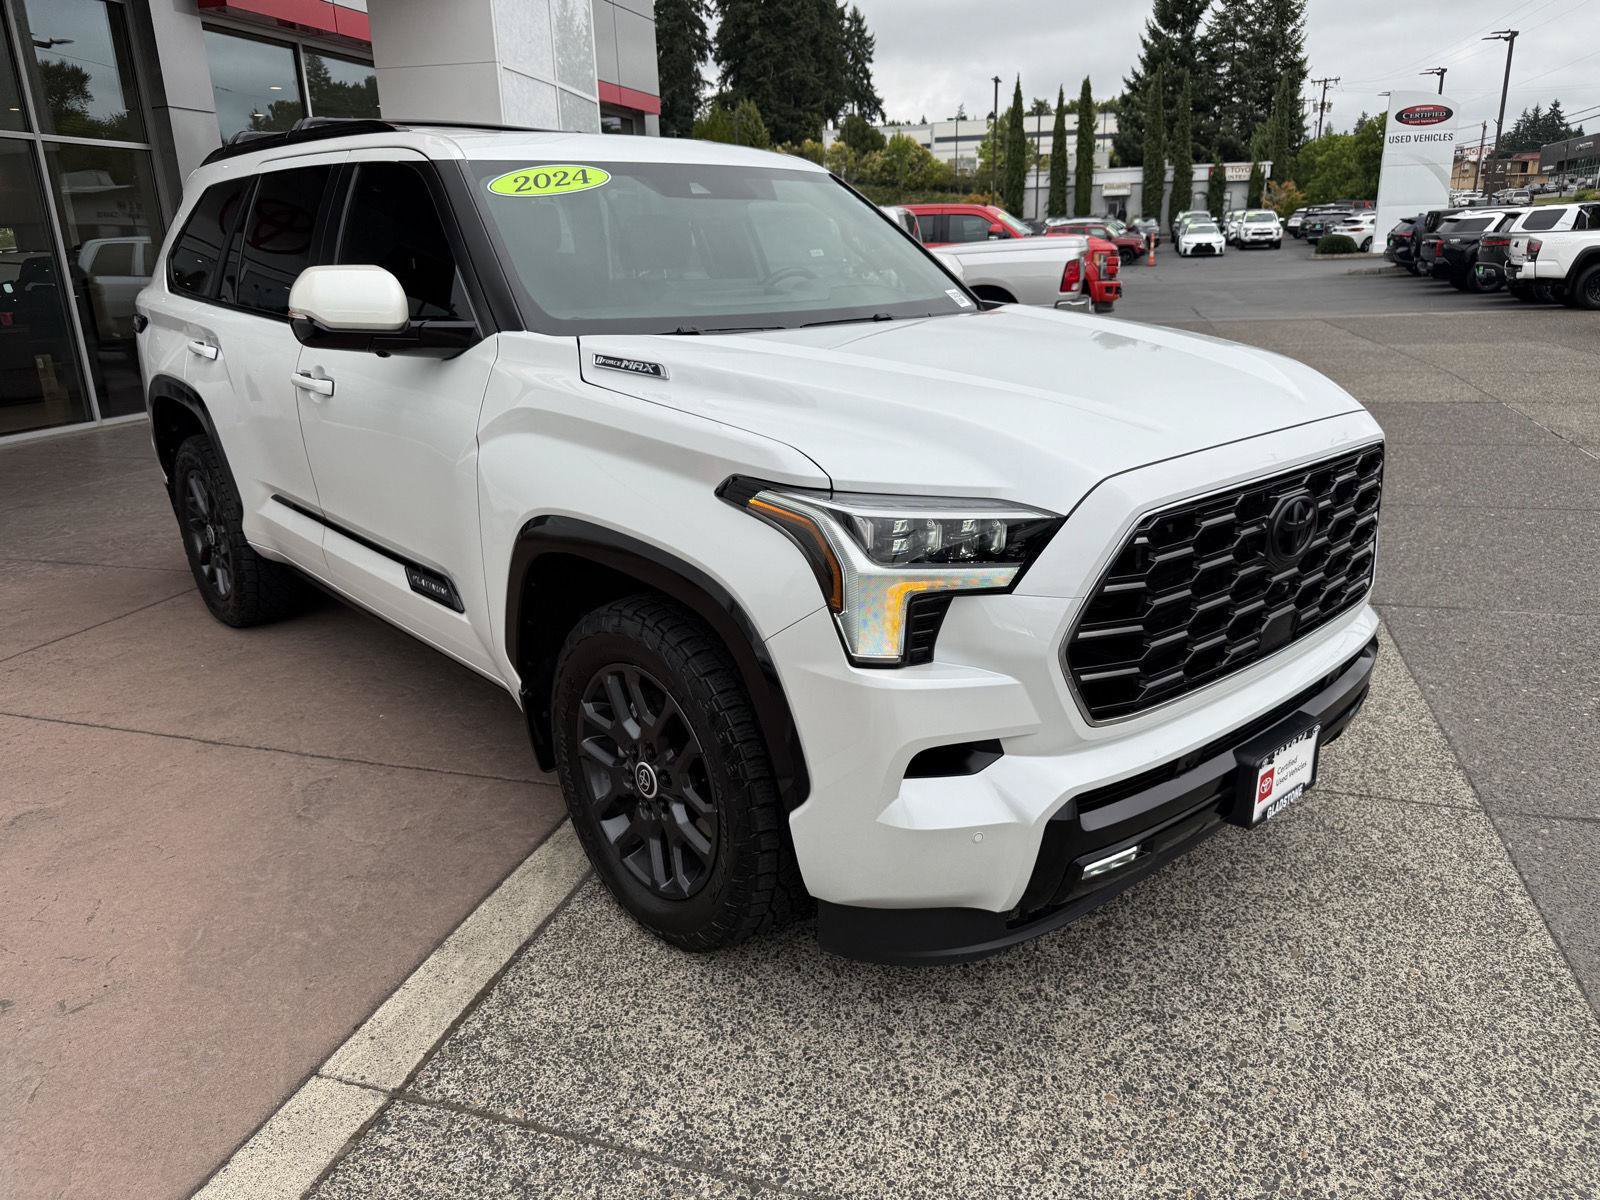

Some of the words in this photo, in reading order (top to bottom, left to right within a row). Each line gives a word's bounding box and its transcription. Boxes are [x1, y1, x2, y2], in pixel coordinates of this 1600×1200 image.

[1402, 111, 1446, 119] CERTIFIED
[1388, 135, 1412, 144] USED
[1413, 132, 1454, 143] VEHICLES
[513, 168, 592, 193] 2024
[412, 575, 447, 594] PLATINUM
[1275, 772, 1289, 787] Used
[1288, 761, 1308, 778] Vehicles
[1276, 755, 1298, 776] Certified
[1266, 784, 1304, 820] GLADSTONE
